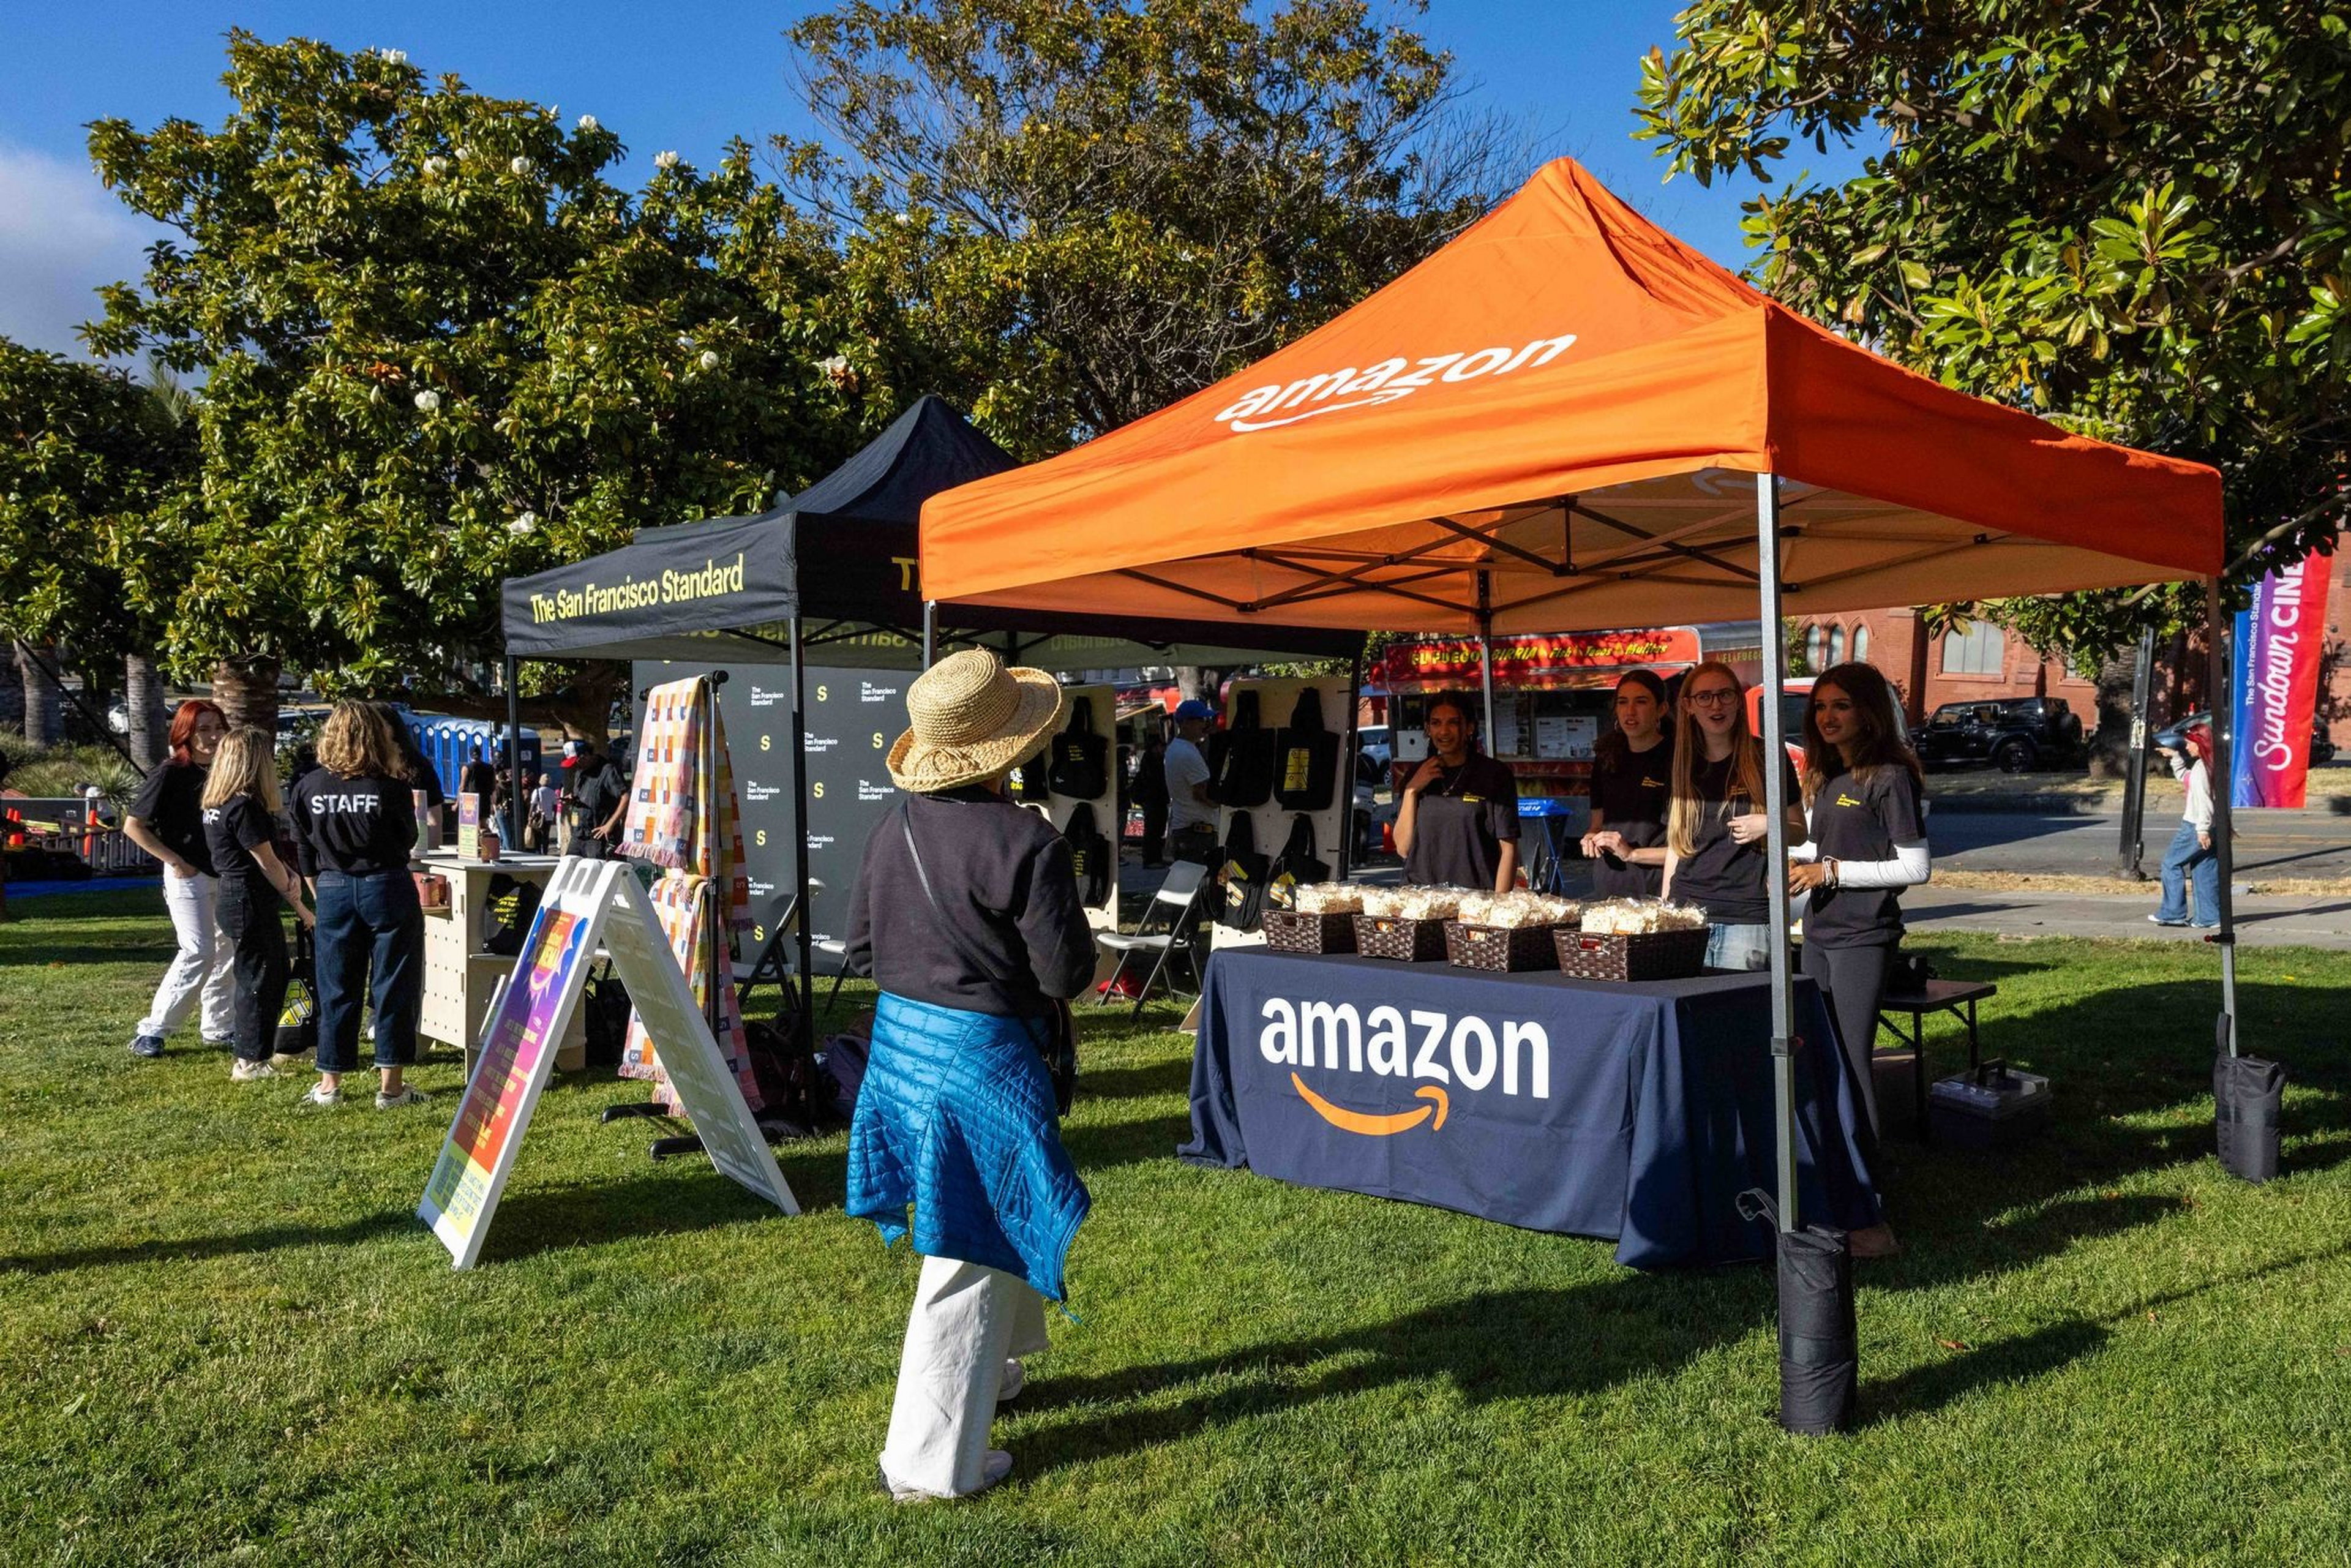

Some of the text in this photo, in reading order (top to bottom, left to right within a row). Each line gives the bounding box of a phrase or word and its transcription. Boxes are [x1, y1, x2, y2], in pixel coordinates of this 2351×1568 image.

[1214, 334, 1578, 422] amazon
[530, 553, 744, 624] The San Francisco Standard
[2246, 581, 2262, 706] The San Francisco Standar
[817, 685, 828, 702] S
[2254, 631, 2300, 771] Sundown
[760, 735, 771, 751] S
[872, 732, 883, 749] S
[813, 782, 824, 798] S
[311, 793, 380, 815] STAFF
[756, 830, 766, 846] S
[754, 925, 763, 941] S
[1259, 997, 1550, 1099] amazon
